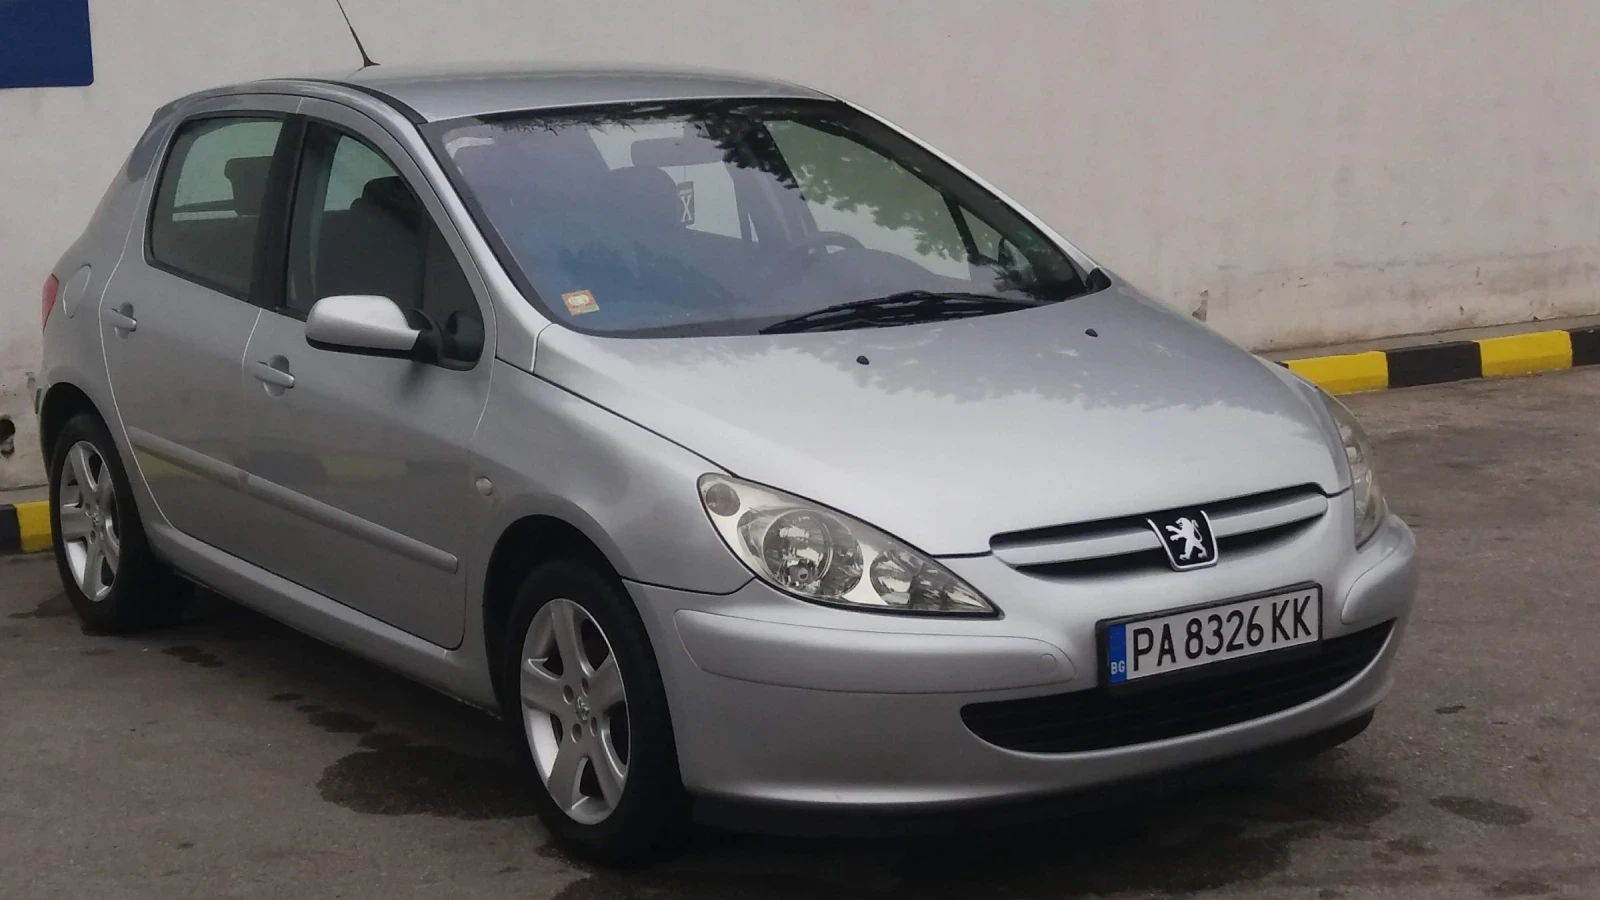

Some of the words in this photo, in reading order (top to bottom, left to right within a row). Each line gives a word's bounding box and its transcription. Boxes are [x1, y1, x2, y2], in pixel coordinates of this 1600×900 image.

[1133, 623, 1176, 671] PA
[1185, 605, 1264, 659] 8326
[1271, 595, 1311, 643] KK
[1110, 660, 1125, 675] BG
